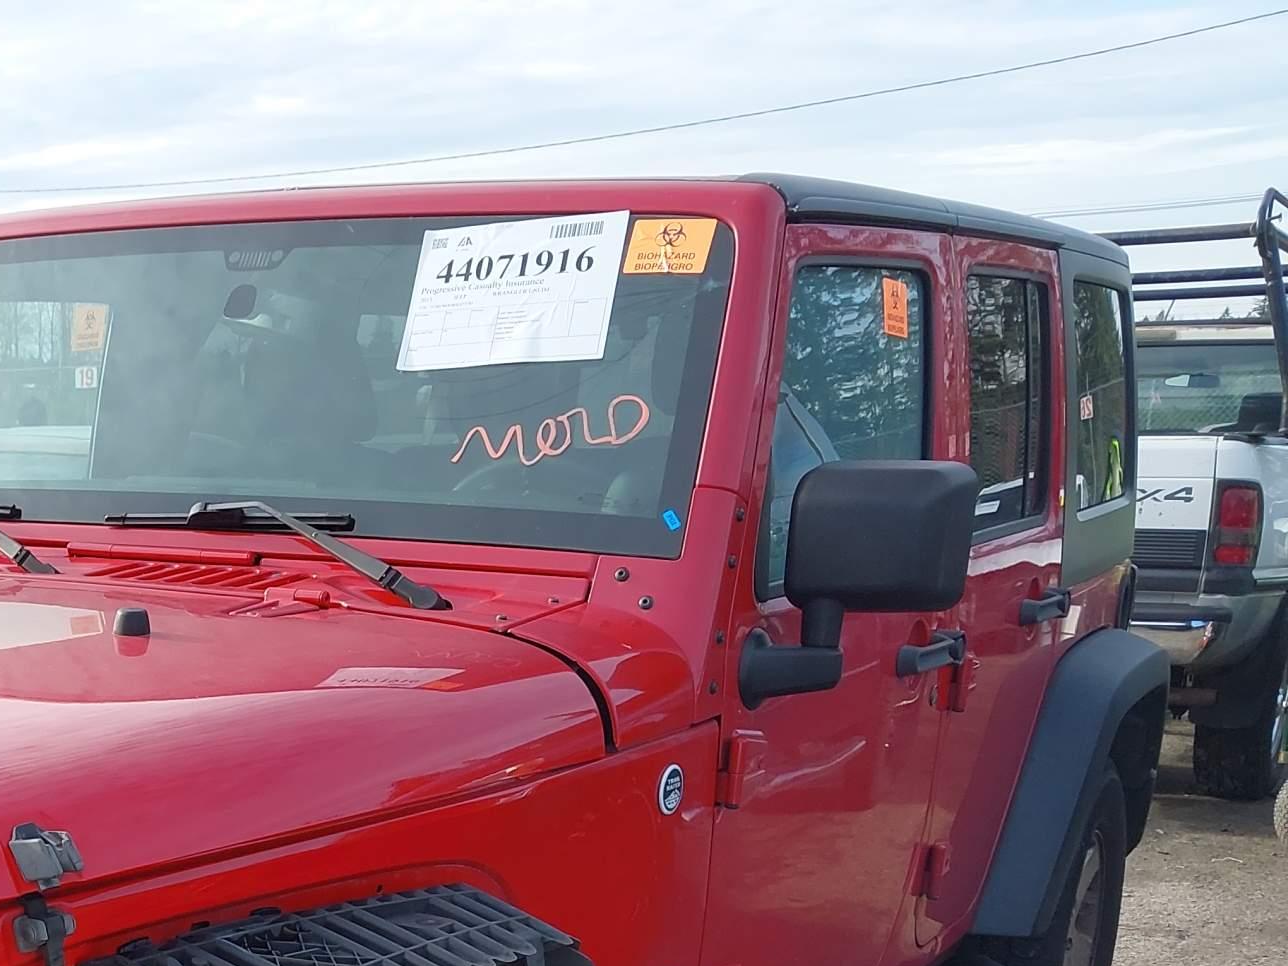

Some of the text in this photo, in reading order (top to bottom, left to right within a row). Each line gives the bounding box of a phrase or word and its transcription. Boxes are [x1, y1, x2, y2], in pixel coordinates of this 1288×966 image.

[637, 251, 696, 261] BIOHAZARD
[436, 245, 596, 284] 44071916
[634, 262, 694, 271] BIOPIGRO
[421, 283, 467, 295] Progressive
[506, 278, 545, 289] Insurance
[1136, 486, 1194, 502] X4
